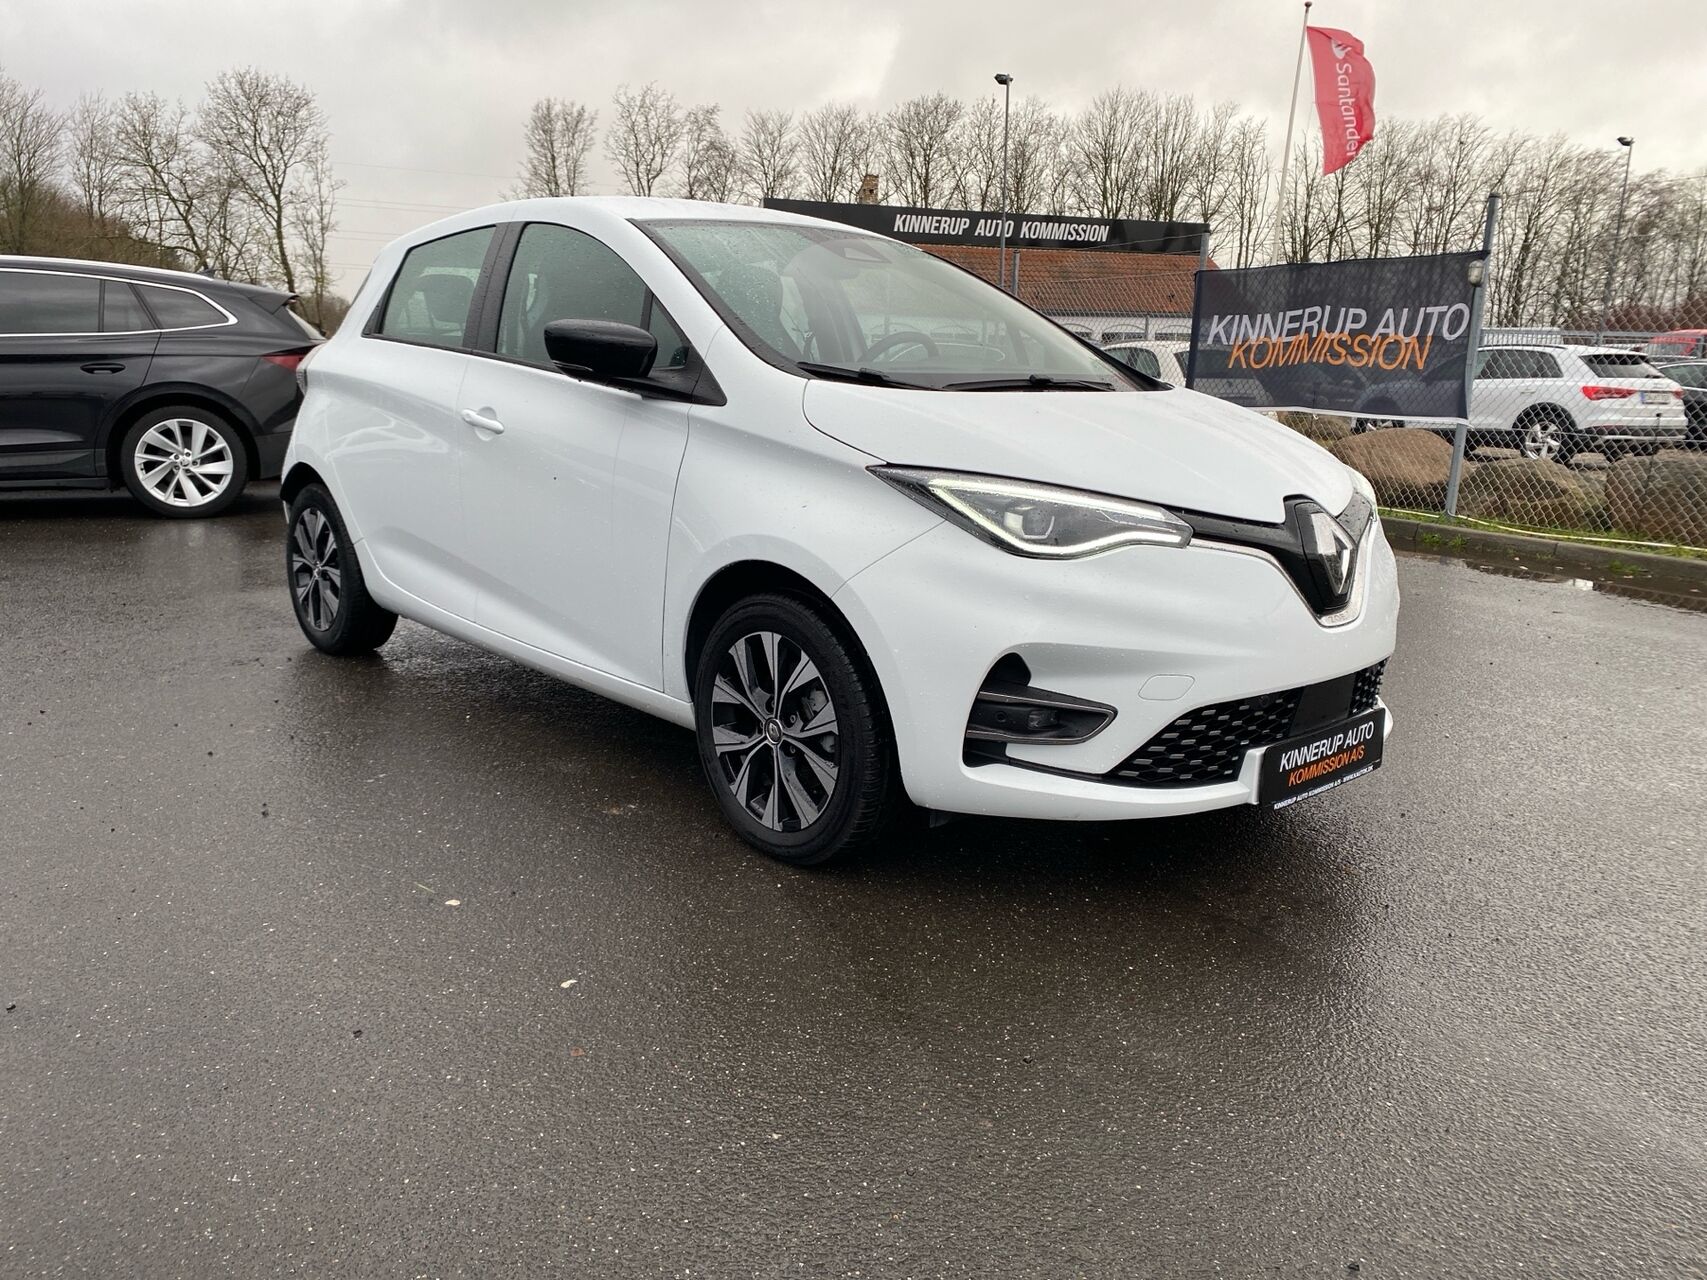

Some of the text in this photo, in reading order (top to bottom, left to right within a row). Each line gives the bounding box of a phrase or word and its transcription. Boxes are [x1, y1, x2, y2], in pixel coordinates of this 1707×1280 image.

[1336, 63, 1360, 156] Santander
[894, 214, 1110, 243] KINNERUP AUTO KOMMISSION
[1207, 303, 1470, 345] KINNERUP AUTO
[1227, 329, 1432, 370] KOMMISSION
[1280, 721, 1374, 772] KINNERUP AUTO
[1288, 745, 1364, 787] KOMMISSION A/S
